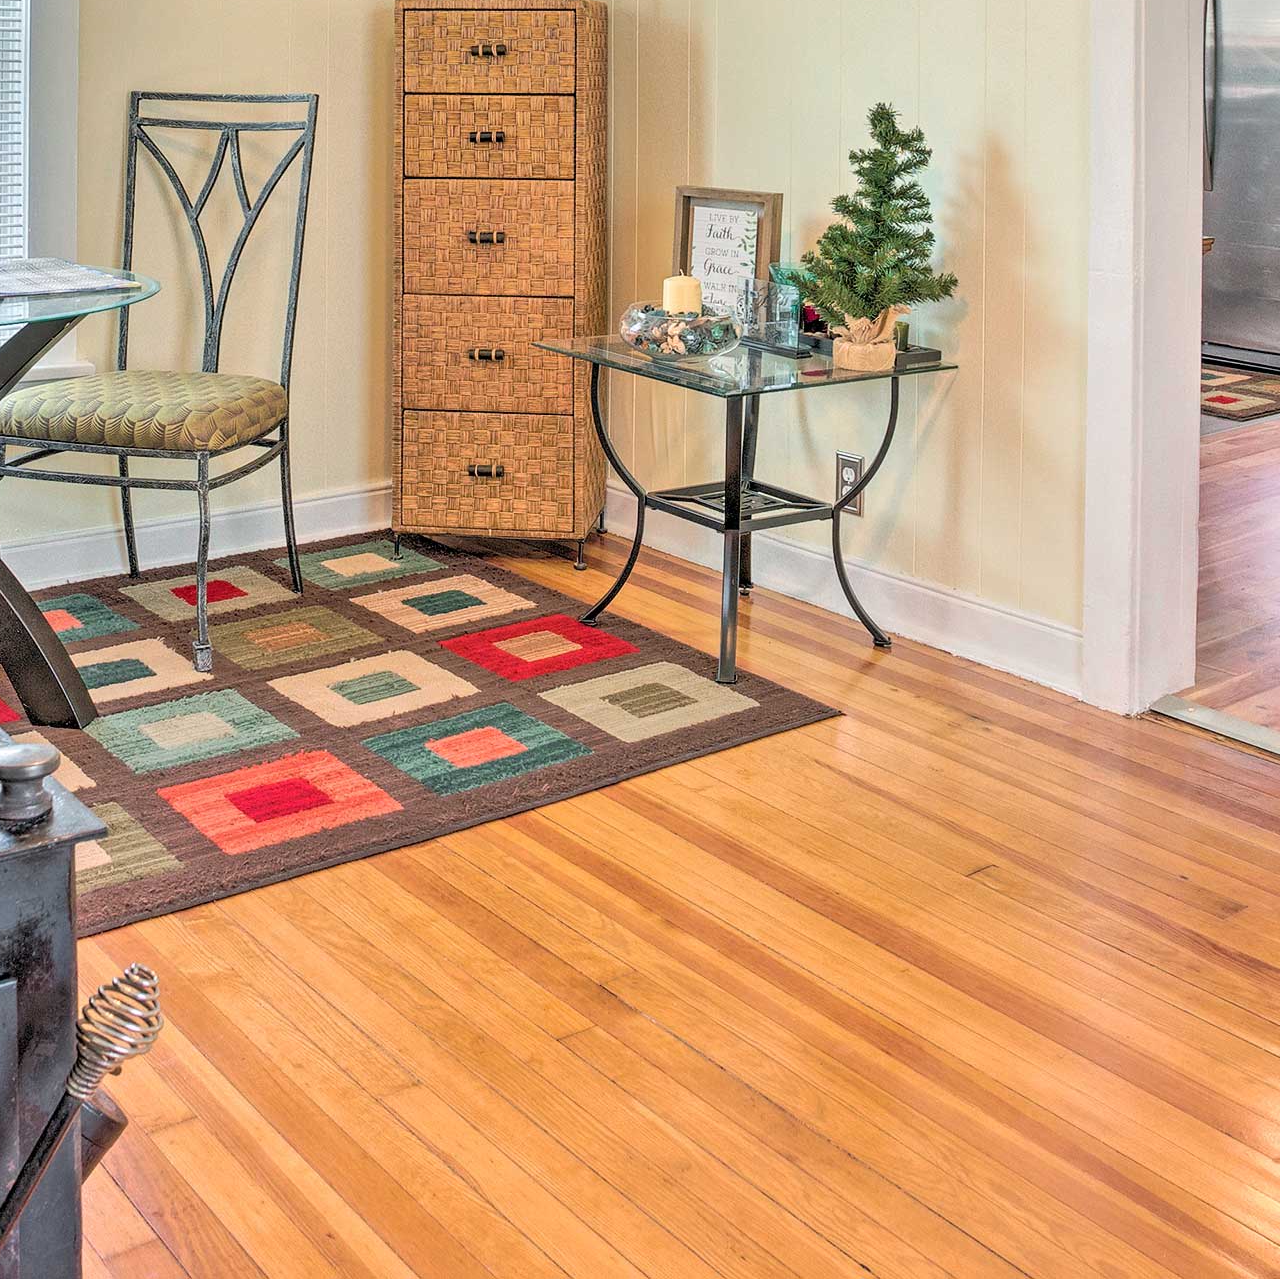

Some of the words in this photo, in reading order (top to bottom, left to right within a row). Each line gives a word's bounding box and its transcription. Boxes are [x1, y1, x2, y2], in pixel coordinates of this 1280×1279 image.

[709, 213, 727, 222] LIVE
[729, 216, 739, 224] BY
[705, 224, 740, 241] Faith
[704, 247, 729, 257] GROW
[730, 250, 739, 258] IN
[703, 257, 740, 276] Grace
[703, 281, 726, 292] WALK
